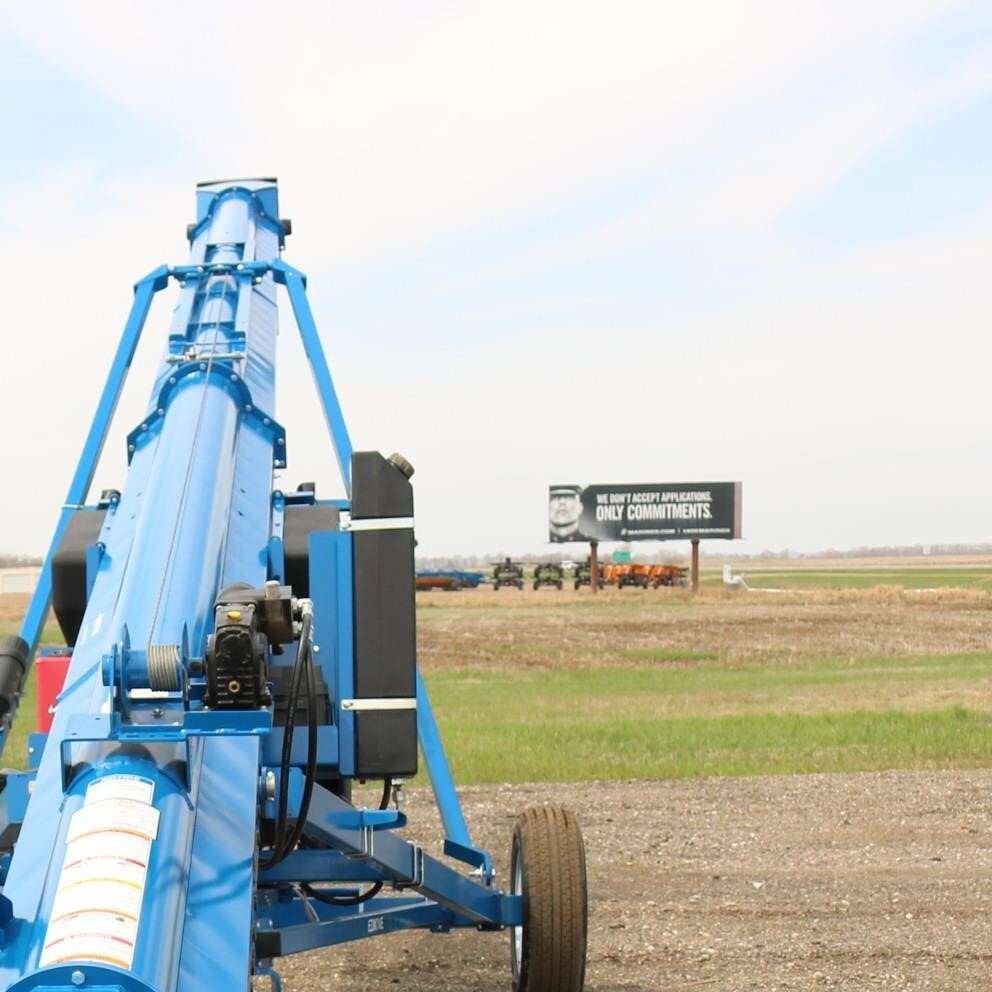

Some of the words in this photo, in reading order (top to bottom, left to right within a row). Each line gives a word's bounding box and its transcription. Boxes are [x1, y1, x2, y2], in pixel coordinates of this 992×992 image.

[596, 493, 608, 504] WE
[609, 493, 631, 504] DON'T
[632, 492, 660, 503] ACCEPT
[661, 491, 713, 502] APPLICATIONS.
[596, 504, 624, 521] ONLY
[627, 503, 713, 520] COMMITMENTS.
